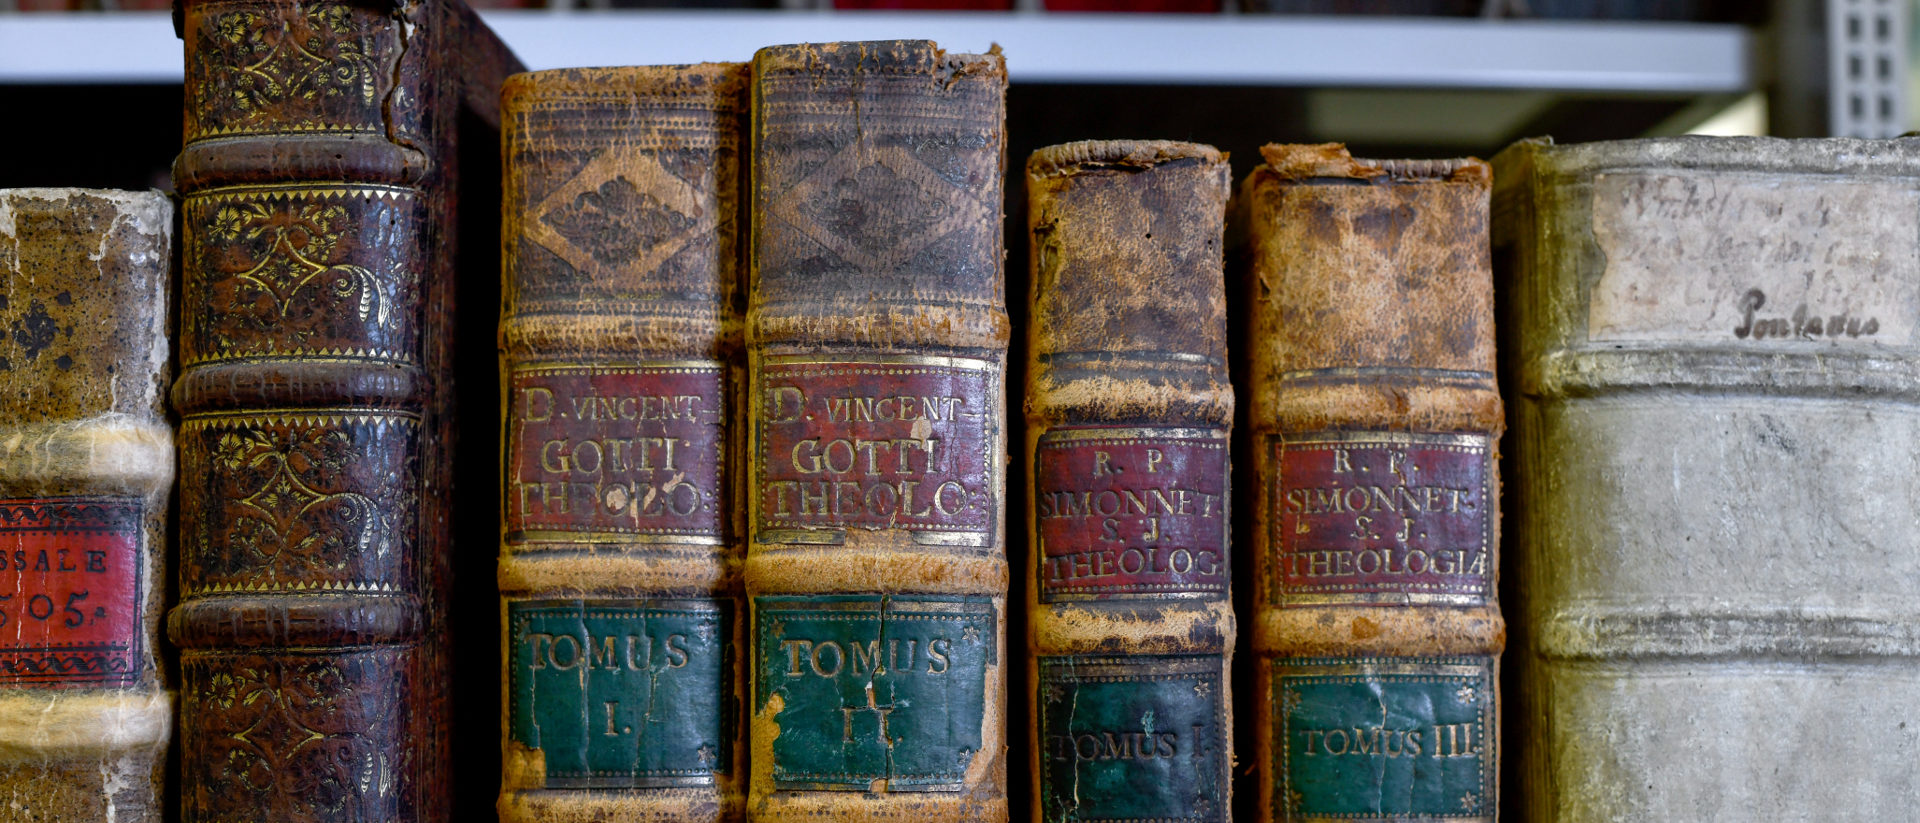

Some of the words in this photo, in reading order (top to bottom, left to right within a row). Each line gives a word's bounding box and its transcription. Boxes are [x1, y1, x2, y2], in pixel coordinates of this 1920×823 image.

[520, 387, 568, 422] D.
[767, 386, 815, 423] D.
[541, 437, 679, 473] GOTTI
[791, 438, 939, 475] GOTTI
[1332, 449, 1370, 473] R.
[1389, 450, 1420, 474] P.
[524, 633, 689, 671] TOMUS
[778, 638, 952, 677] TOMUS
[604, 701, 632, 735] I.
[1052, 730, 1176, 762] TOMUS
[1302, 727, 1422, 758] TOMUS
